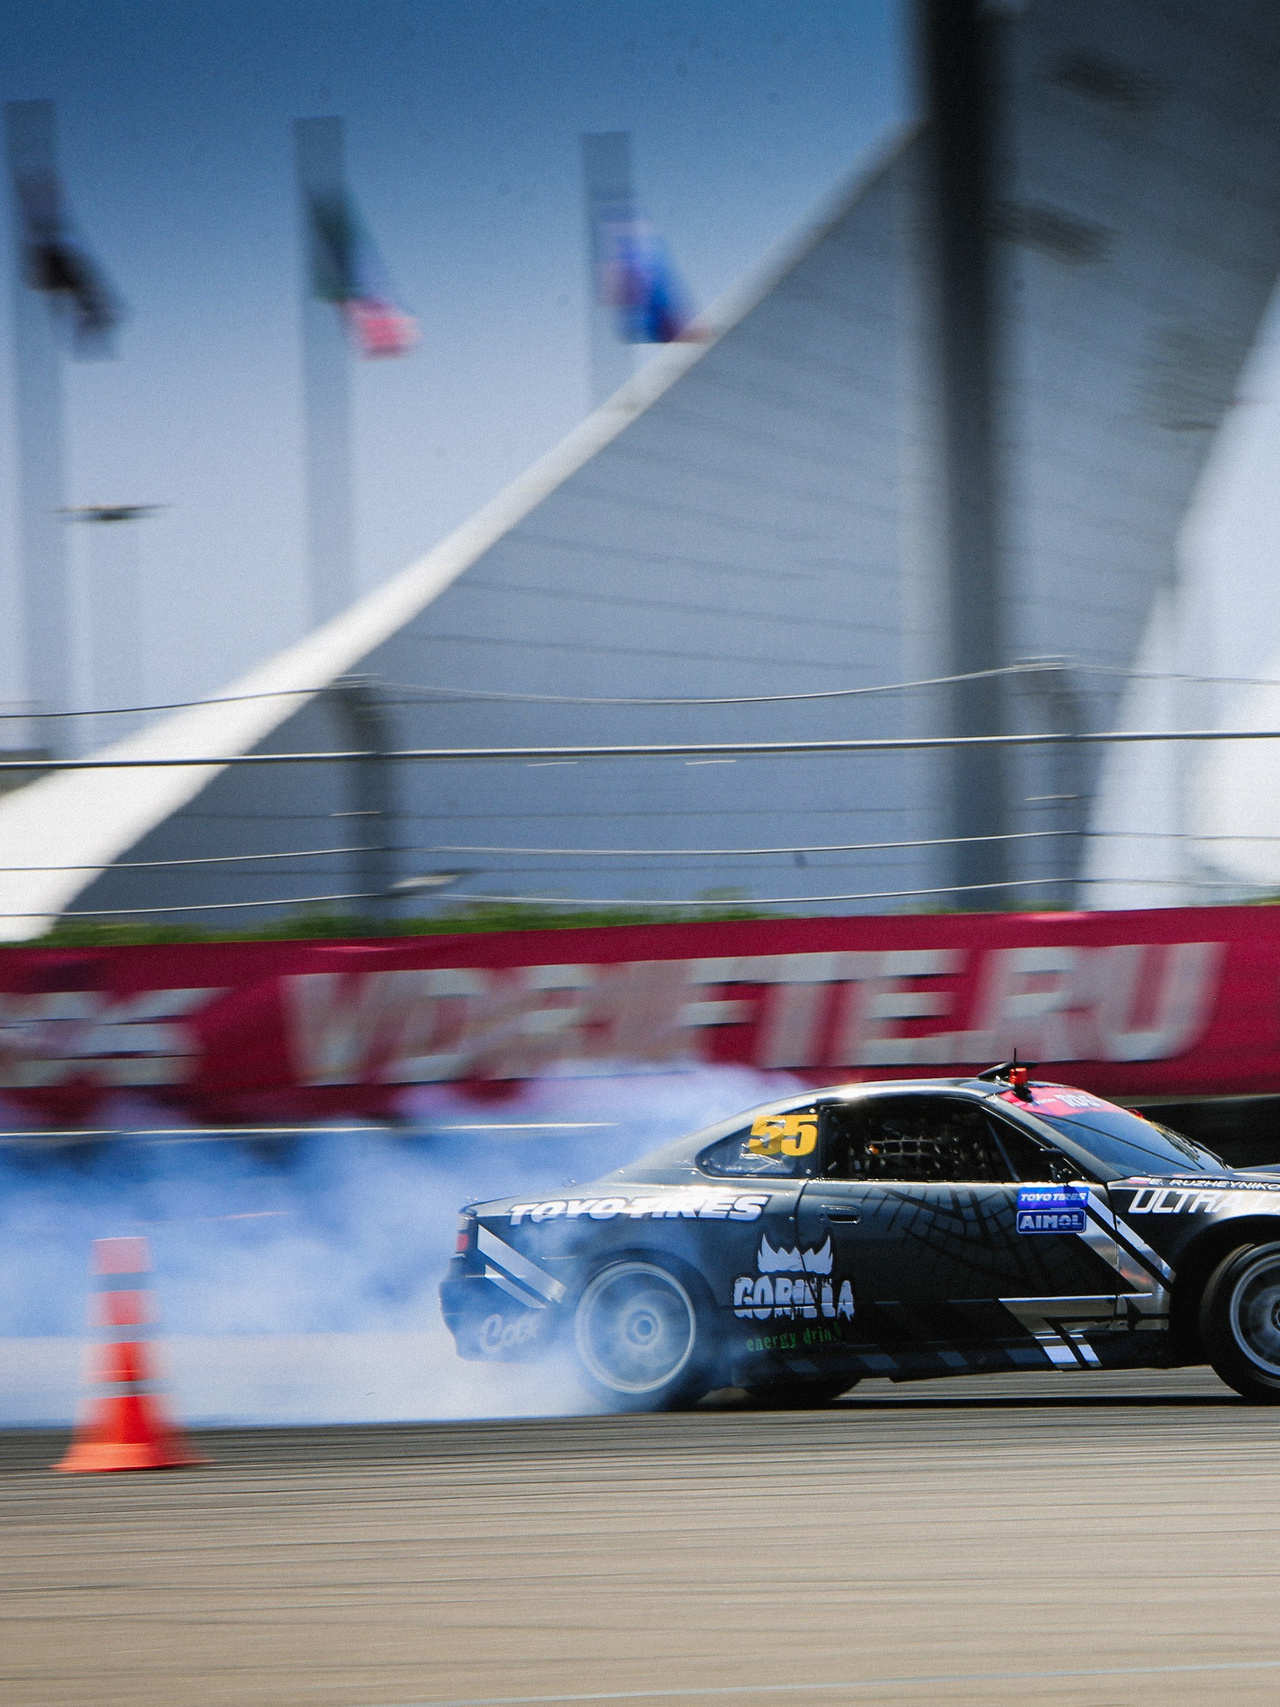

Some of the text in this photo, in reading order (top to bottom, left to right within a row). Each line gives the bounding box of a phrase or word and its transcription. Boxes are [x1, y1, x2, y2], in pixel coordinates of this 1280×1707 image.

[748, 1114, 818, 1156] 55
[509, 1194, 772, 1226] TOYO TIRES
[1020, 1192, 1053, 1202] TOYO
[1128, 1188, 1237, 1215] ULTRA
[1019, 1214, 1083, 1229] AIMOL
[733, 1275, 855, 1322] GORILLA
[746, 1332, 797, 1352] energy
